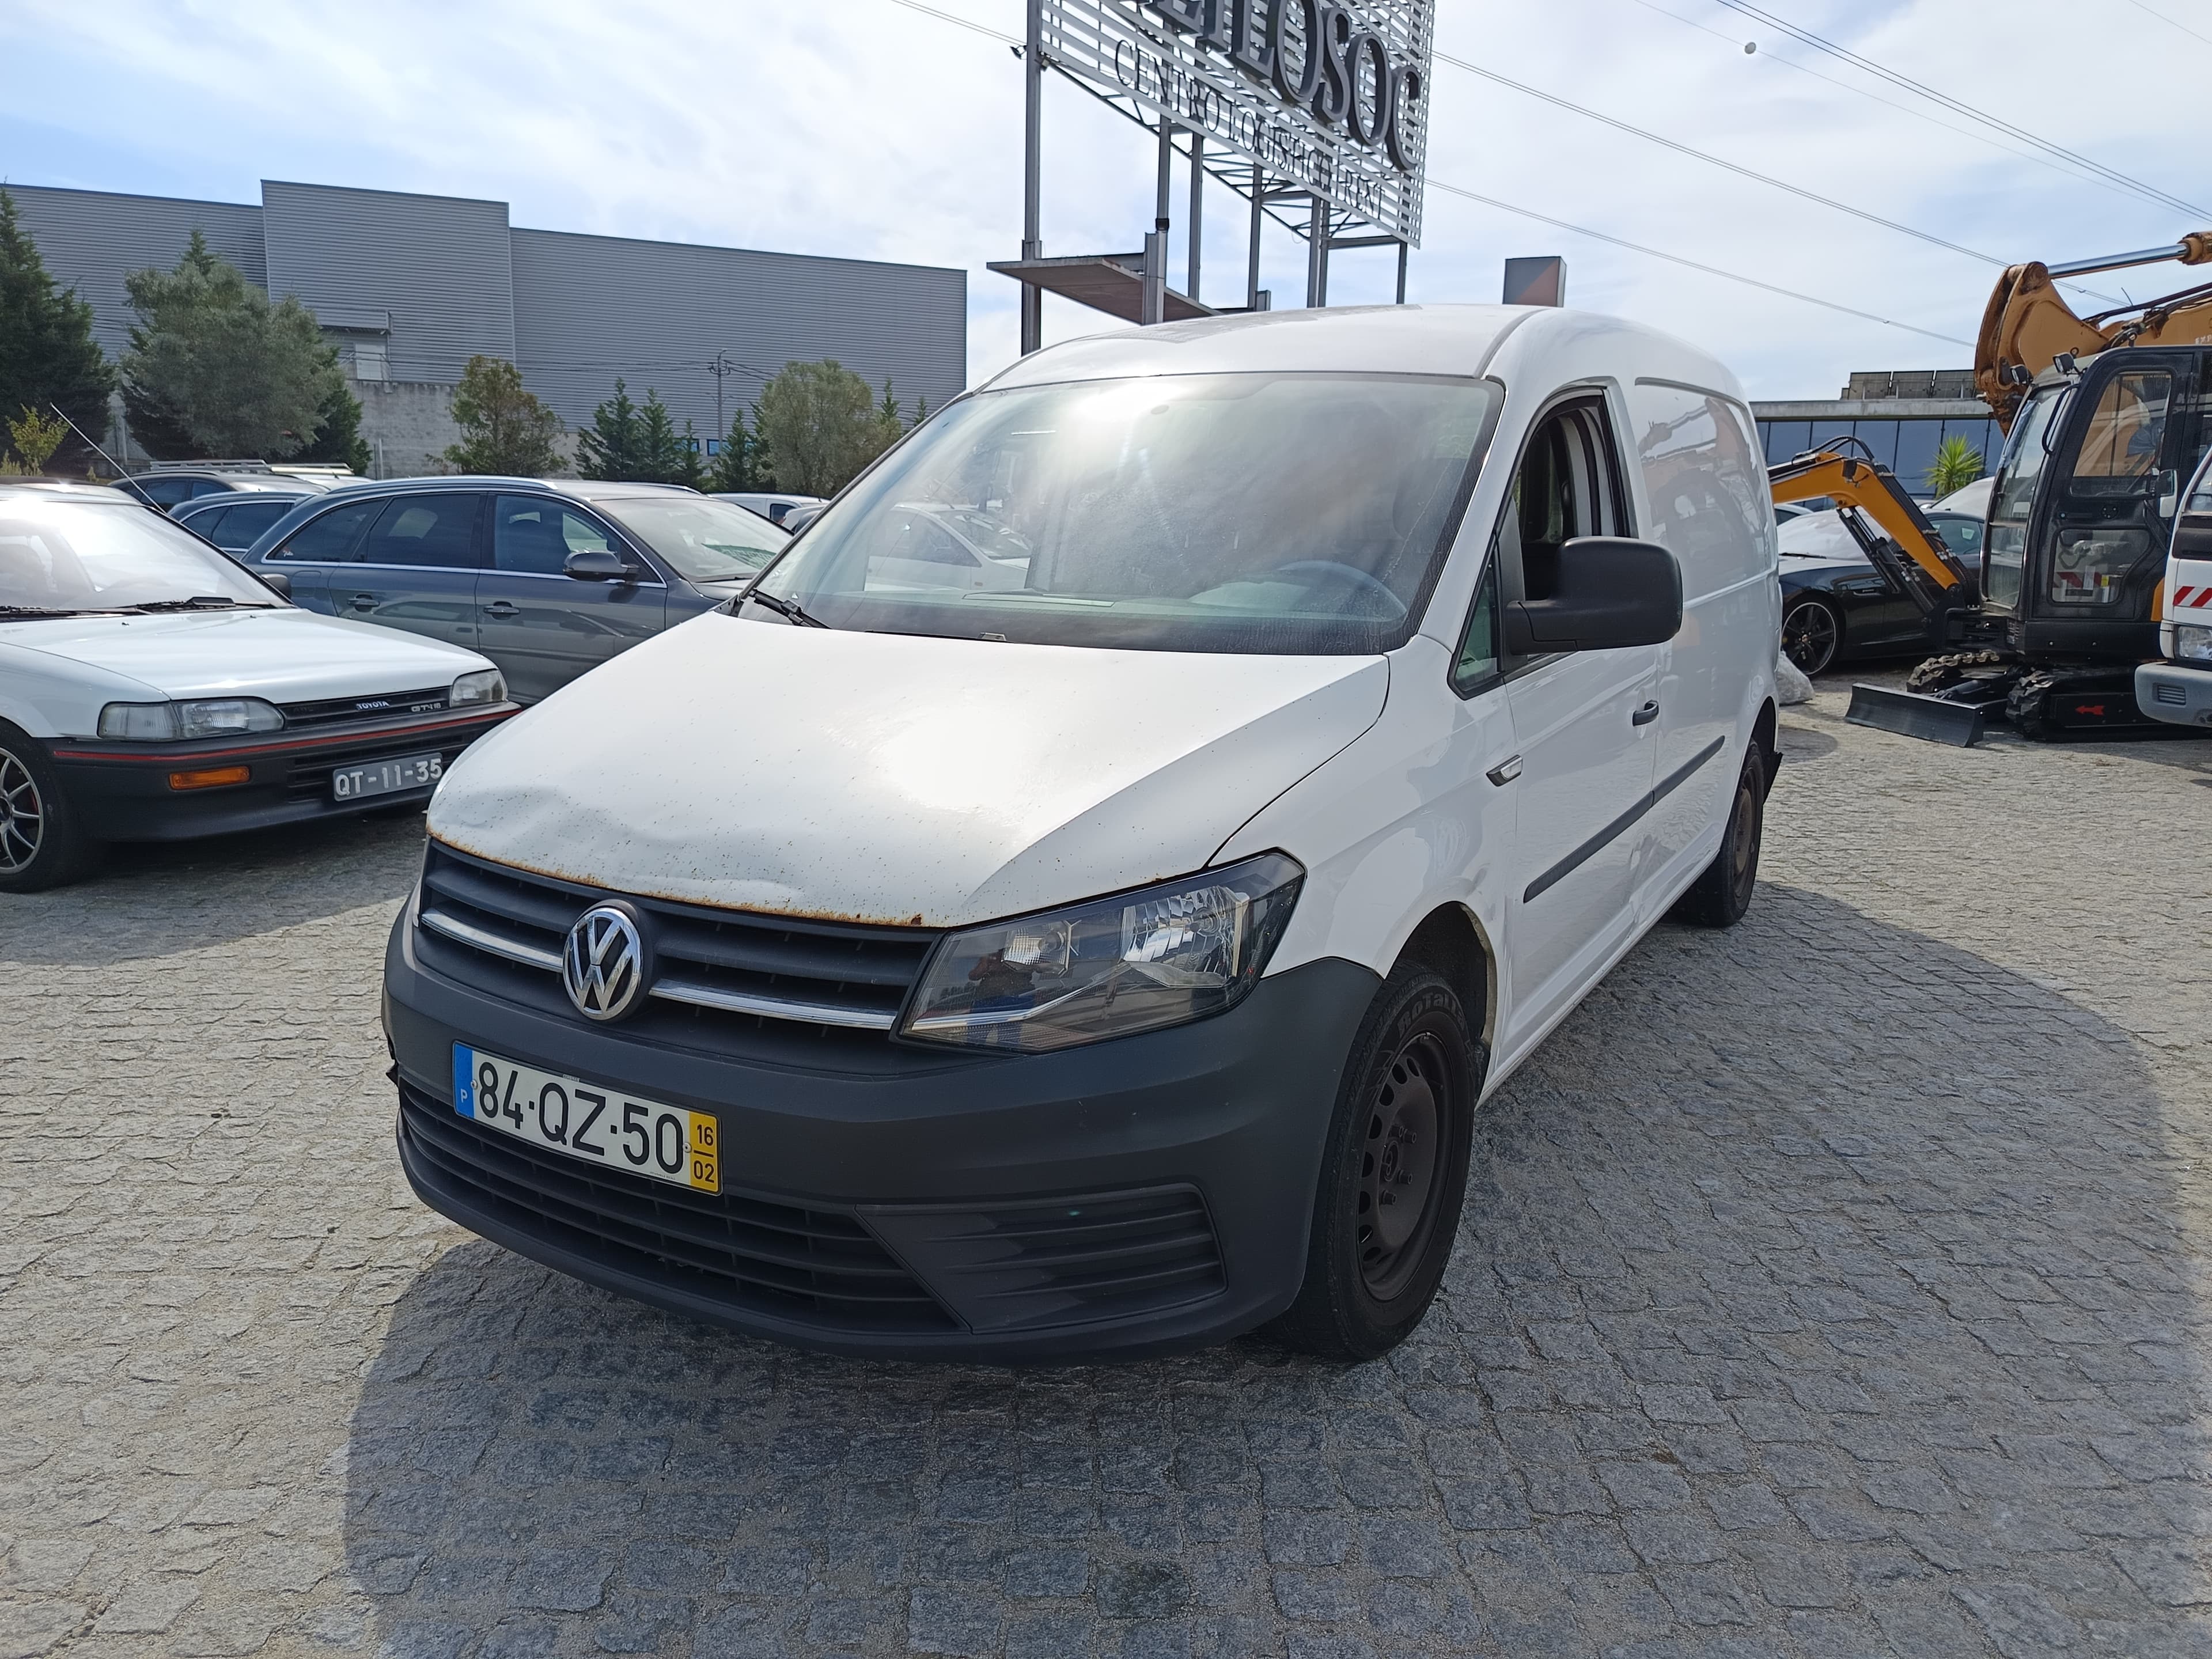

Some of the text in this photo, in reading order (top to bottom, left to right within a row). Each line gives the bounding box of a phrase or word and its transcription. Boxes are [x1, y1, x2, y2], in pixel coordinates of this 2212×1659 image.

[1115, 39, 1220, 132] CENTRO
[356, 700, 389, 710] TOYOTA
[335, 758, 442, 796] QT-11-35
[461, 1088, 468, 1103] P
[697, 1124, 714, 1146] 16
[694, 1160, 715, 1183] 02
